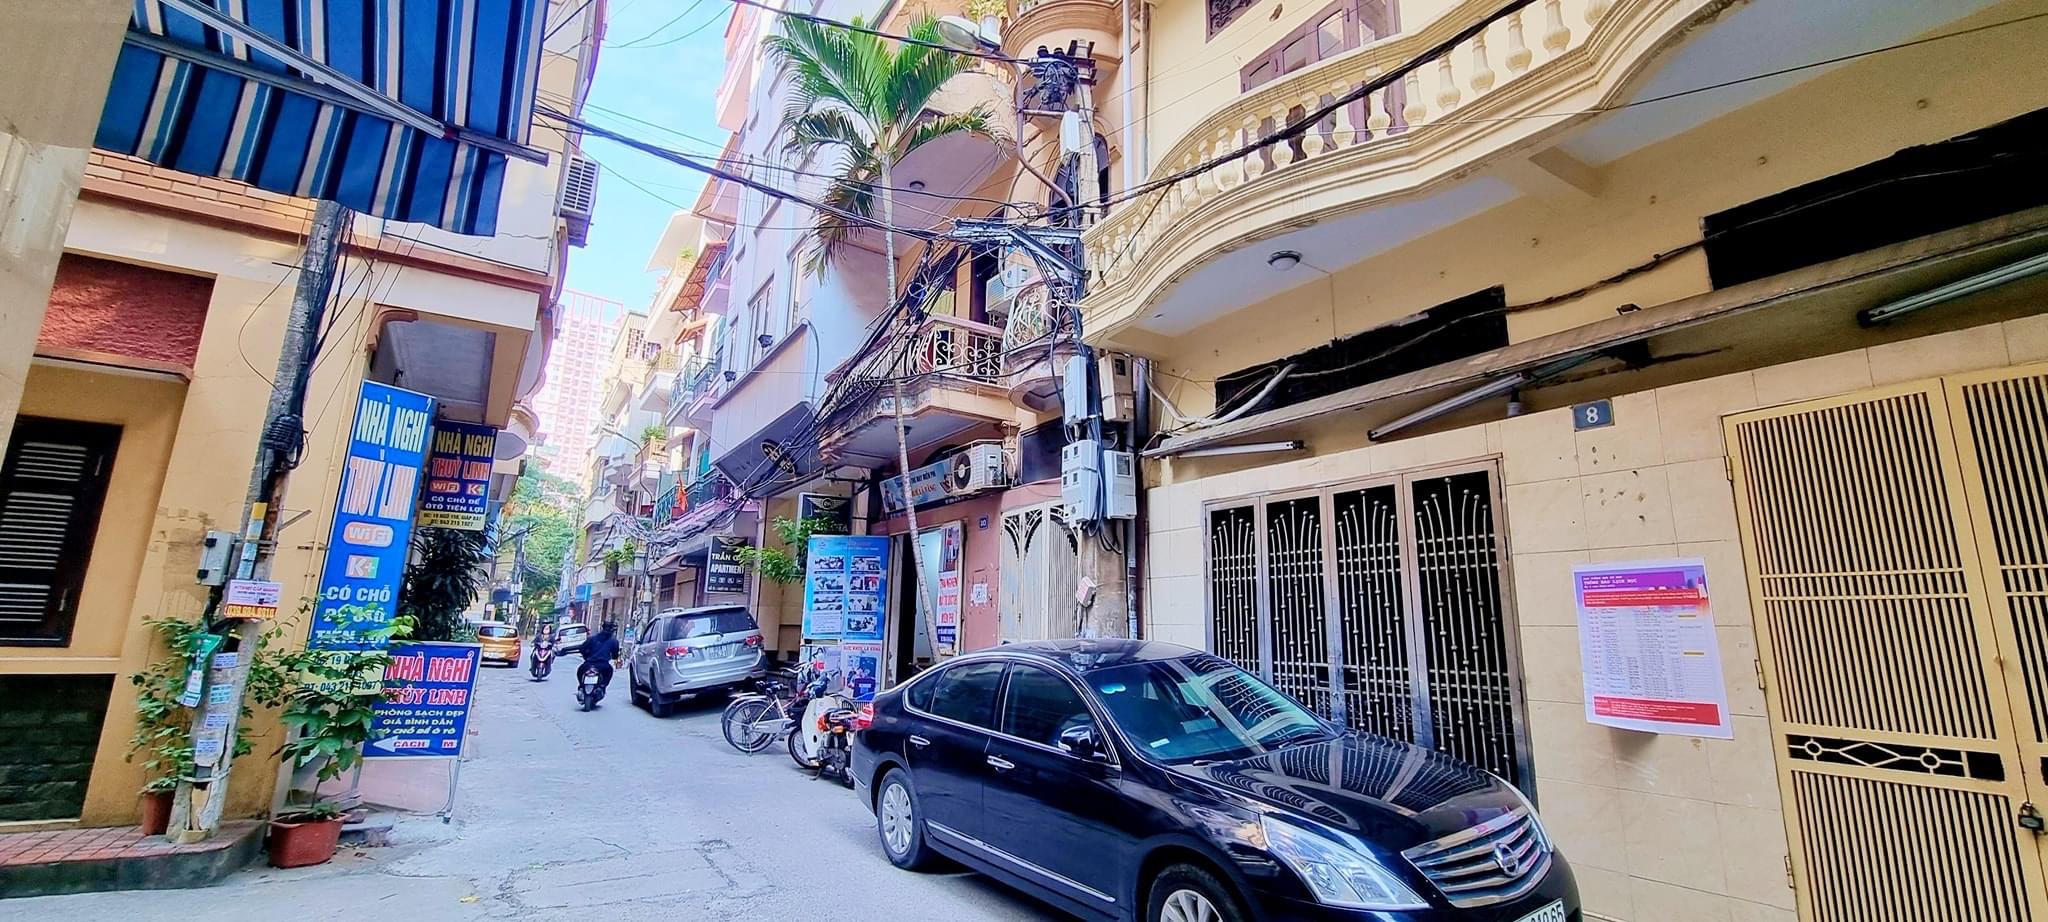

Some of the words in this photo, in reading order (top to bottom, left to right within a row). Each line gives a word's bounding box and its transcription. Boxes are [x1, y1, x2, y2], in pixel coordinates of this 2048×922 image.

[1586, 406, 1598, 423] 8
[355, 395, 390, 446] NHÀ
[389, 397, 432, 453] NGHỈ
[435, 429, 462, 453] NHÀ
[463, 461, 490, 481] LINH
[378, 463, 417, 520] LINH
[710, 563, 745, 574] APARTMENT
[326, 584, 352, 600] CÓ
[356, 585, 391, 602] CHỖ
[384, 651, 425, 681] NHÀ
[426, 650, 475, 683] NGHỈ
[427, 688, 468, 706] LINH
[374, 708, 413, 716] PHÒNG
[414, 709, 444, 718] SẠCH
[445, 710, 465, 718] ĐẸP
[382, 717, 402, 726] GIÁ
[404, 717, 429, 726] BÌNH
[431, 718, 454, 726] DÂN
